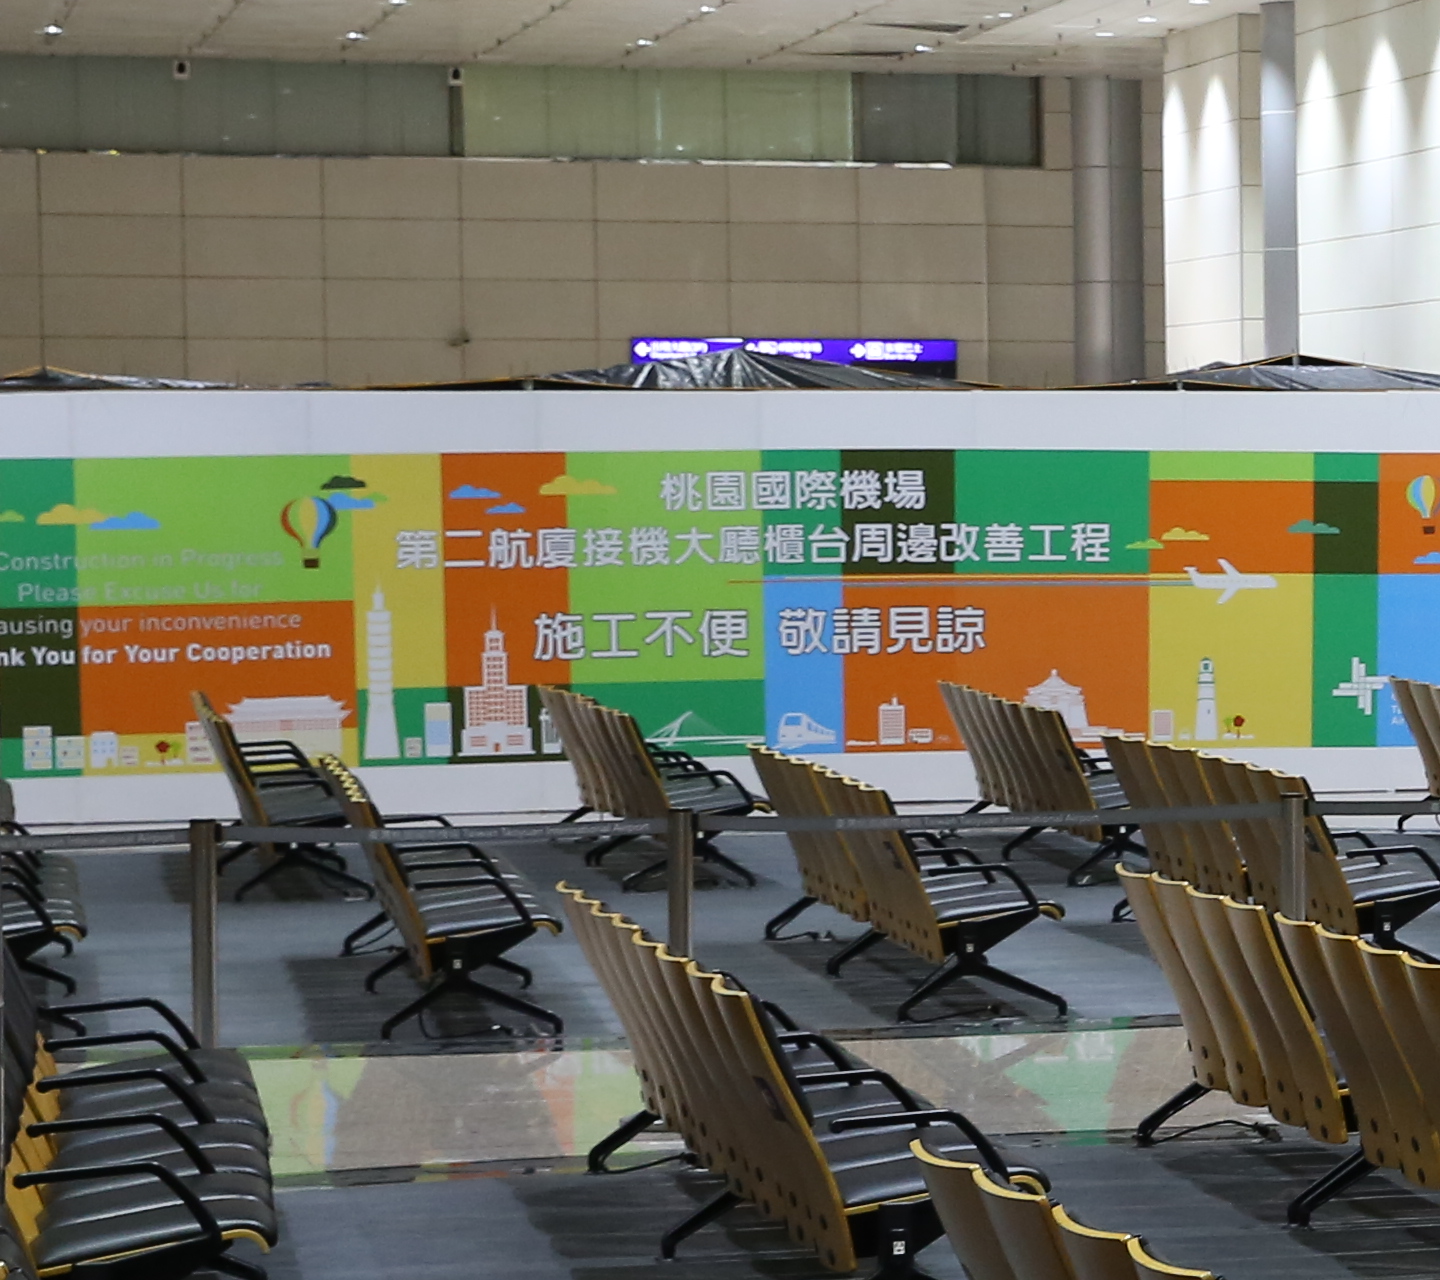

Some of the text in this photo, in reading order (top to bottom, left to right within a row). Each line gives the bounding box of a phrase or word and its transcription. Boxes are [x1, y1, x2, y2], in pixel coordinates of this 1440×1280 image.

[660, 468, 926, 511] 桃園國際機場
[181, 548, 283, 570] Progress
[396, 522, 1112, 570] 第二航廈接機大廳櫃台周邊改善工程
[17, 582, 96, 603] Please
[105, 581, 185, 602] Excuse
[80, 618, 132, 637] your
[139, 611, 302, 632] inconvenience
[533, 605, 987, 661] 施工不便 敬請見諒
[31, 645, 75, 666] You
[82, 645, 118, 665] for
[124, 643, 179, 663] Your
[186, 640, 331, 665] Cooperation
